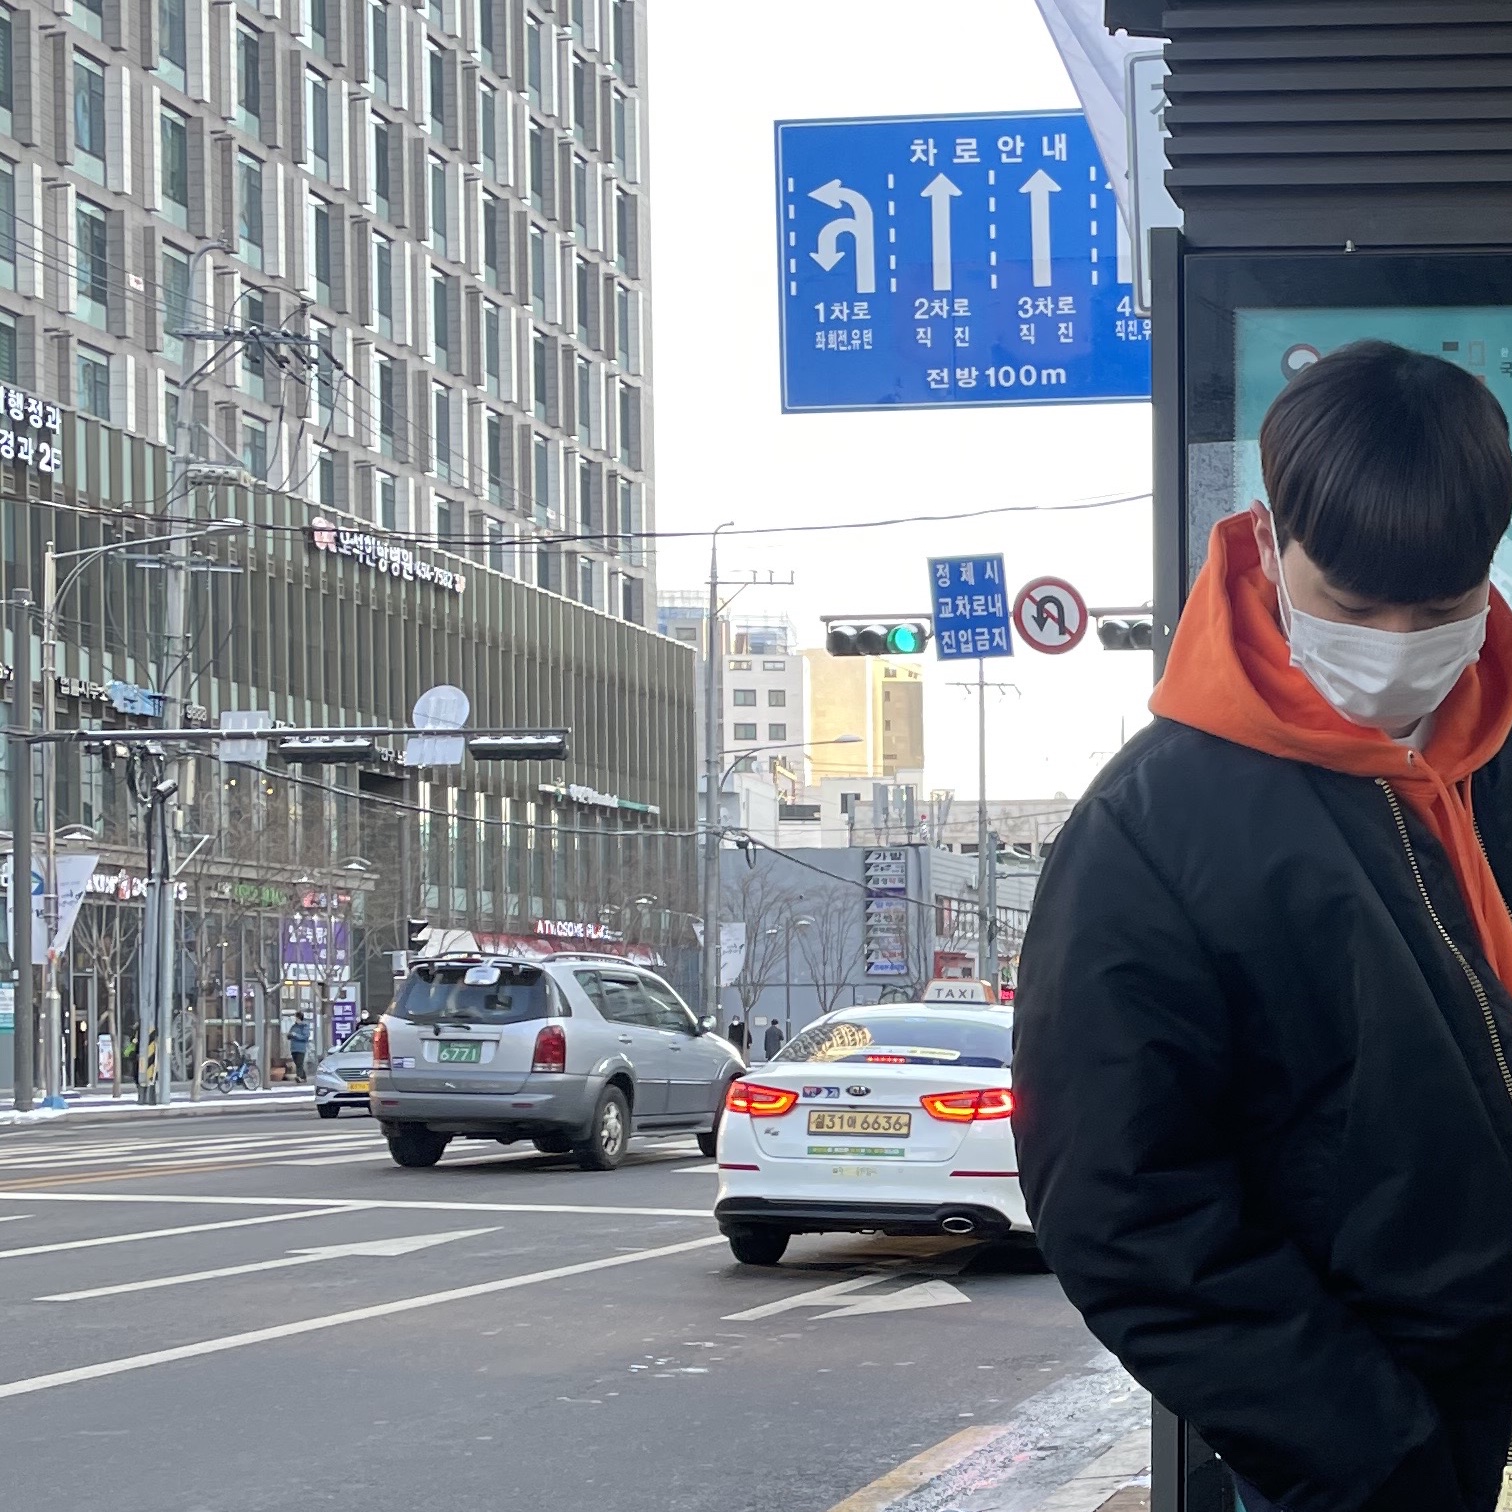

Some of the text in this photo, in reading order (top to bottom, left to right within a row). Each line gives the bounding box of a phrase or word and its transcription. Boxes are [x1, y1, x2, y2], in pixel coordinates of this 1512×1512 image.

[814, 302, 872, 323] 1차로
[914, 298, 972, 320] 2차로
[1018, 296, 1076, 319] 3차로
[0, 385, 61, 435] 행정과
[39, 442, 62, 473] 2F
[938, 593, 1004, 620] 교차로내
[941, 626, 1008, 654] 진입금지
[935, 988, 975, 999] TAXI
[441, 1048, 477, 1061] 6771
[860, 1115, 903, 1131] 6636
